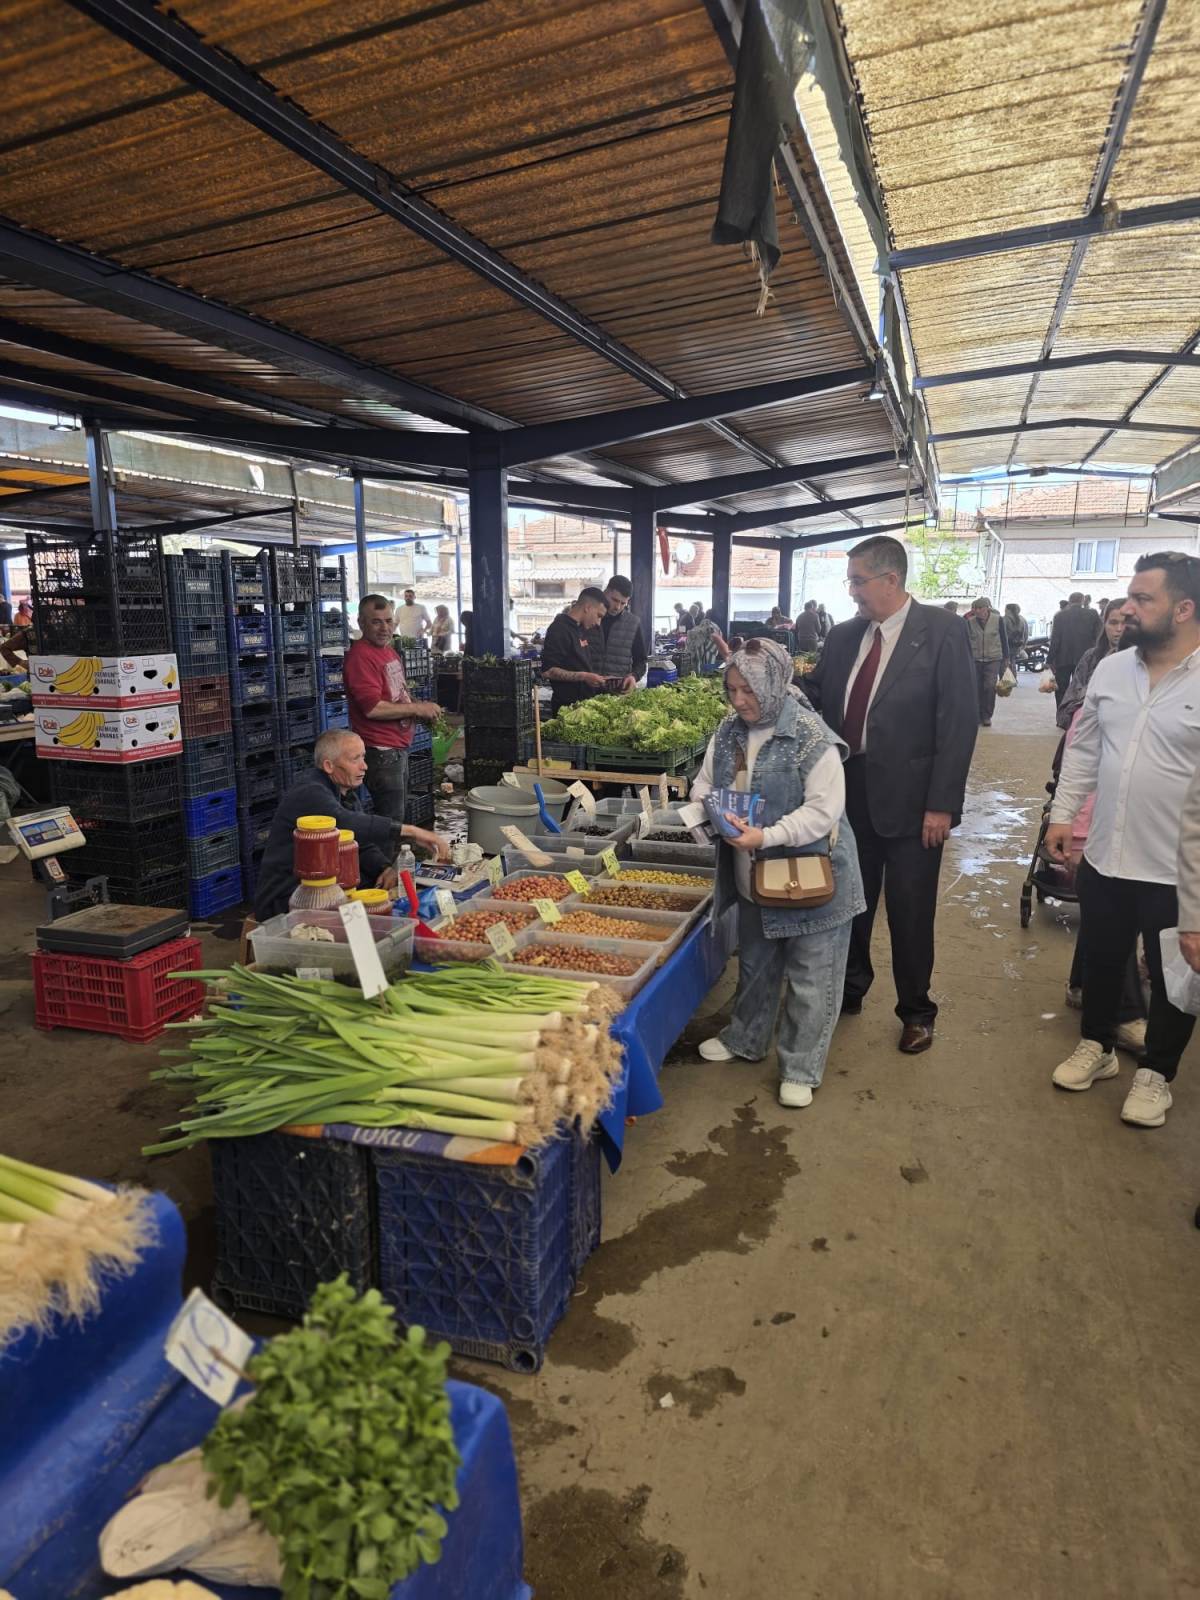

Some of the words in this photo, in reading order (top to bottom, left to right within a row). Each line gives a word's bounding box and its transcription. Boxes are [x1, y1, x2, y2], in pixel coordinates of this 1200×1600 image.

[123, 662, 135, 670] Dole
[38, 666, 54, 677] Dole
[43, 719, 58, 729] Dole
